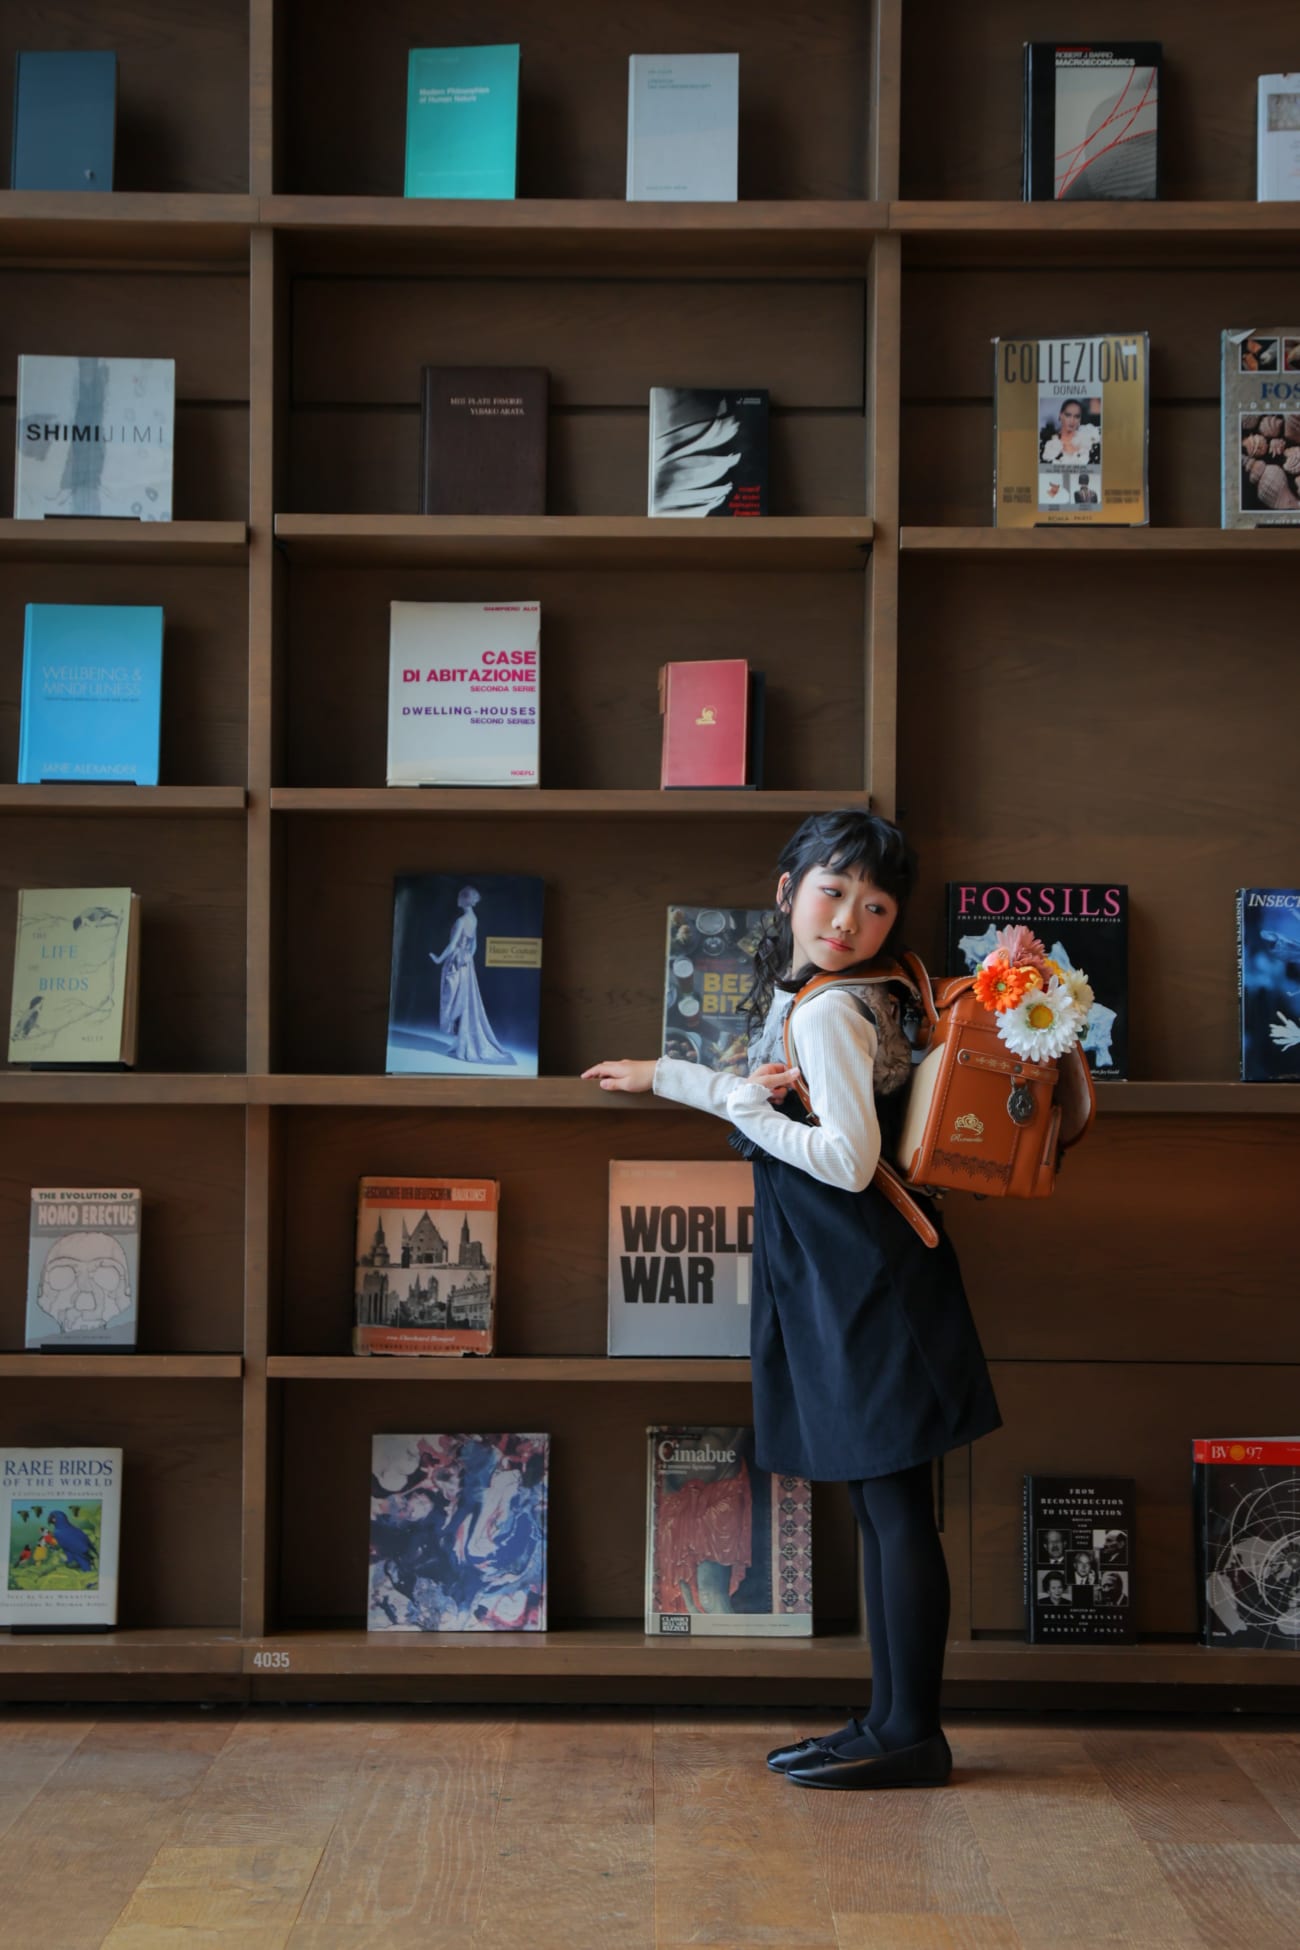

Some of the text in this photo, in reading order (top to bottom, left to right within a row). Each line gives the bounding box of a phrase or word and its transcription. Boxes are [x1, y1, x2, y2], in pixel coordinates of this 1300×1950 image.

[1004, 340, 1138, 383] COLLEZIONI
[1053, 385, 1087, 395] DONNA
[481, 651, 537, 665] CASE
[402, 669, 537, 683] DI ABITAZIONE
[506, 717, 535, 725] SERIES
[958, 887, 1121, 916] FOSSILS
[41, 945, 79, 960] LIFE
[39, 978, 89, 991] BIRDS
[37, 1205, 136, 1225] HOMO ERECTUS
[620, 1206, 755, 1253] WORLD
[620, 1256, 714, 1303] WAR
[658, 1441, 736, 1463] Cimabue
[5, 1460, 113, 1476] RARE BIRDS
[26, 1478, 54, 1486] THE
[60, 1478, 113, 1487] WORLD
[253, 1652, 290, 1668] 4035
